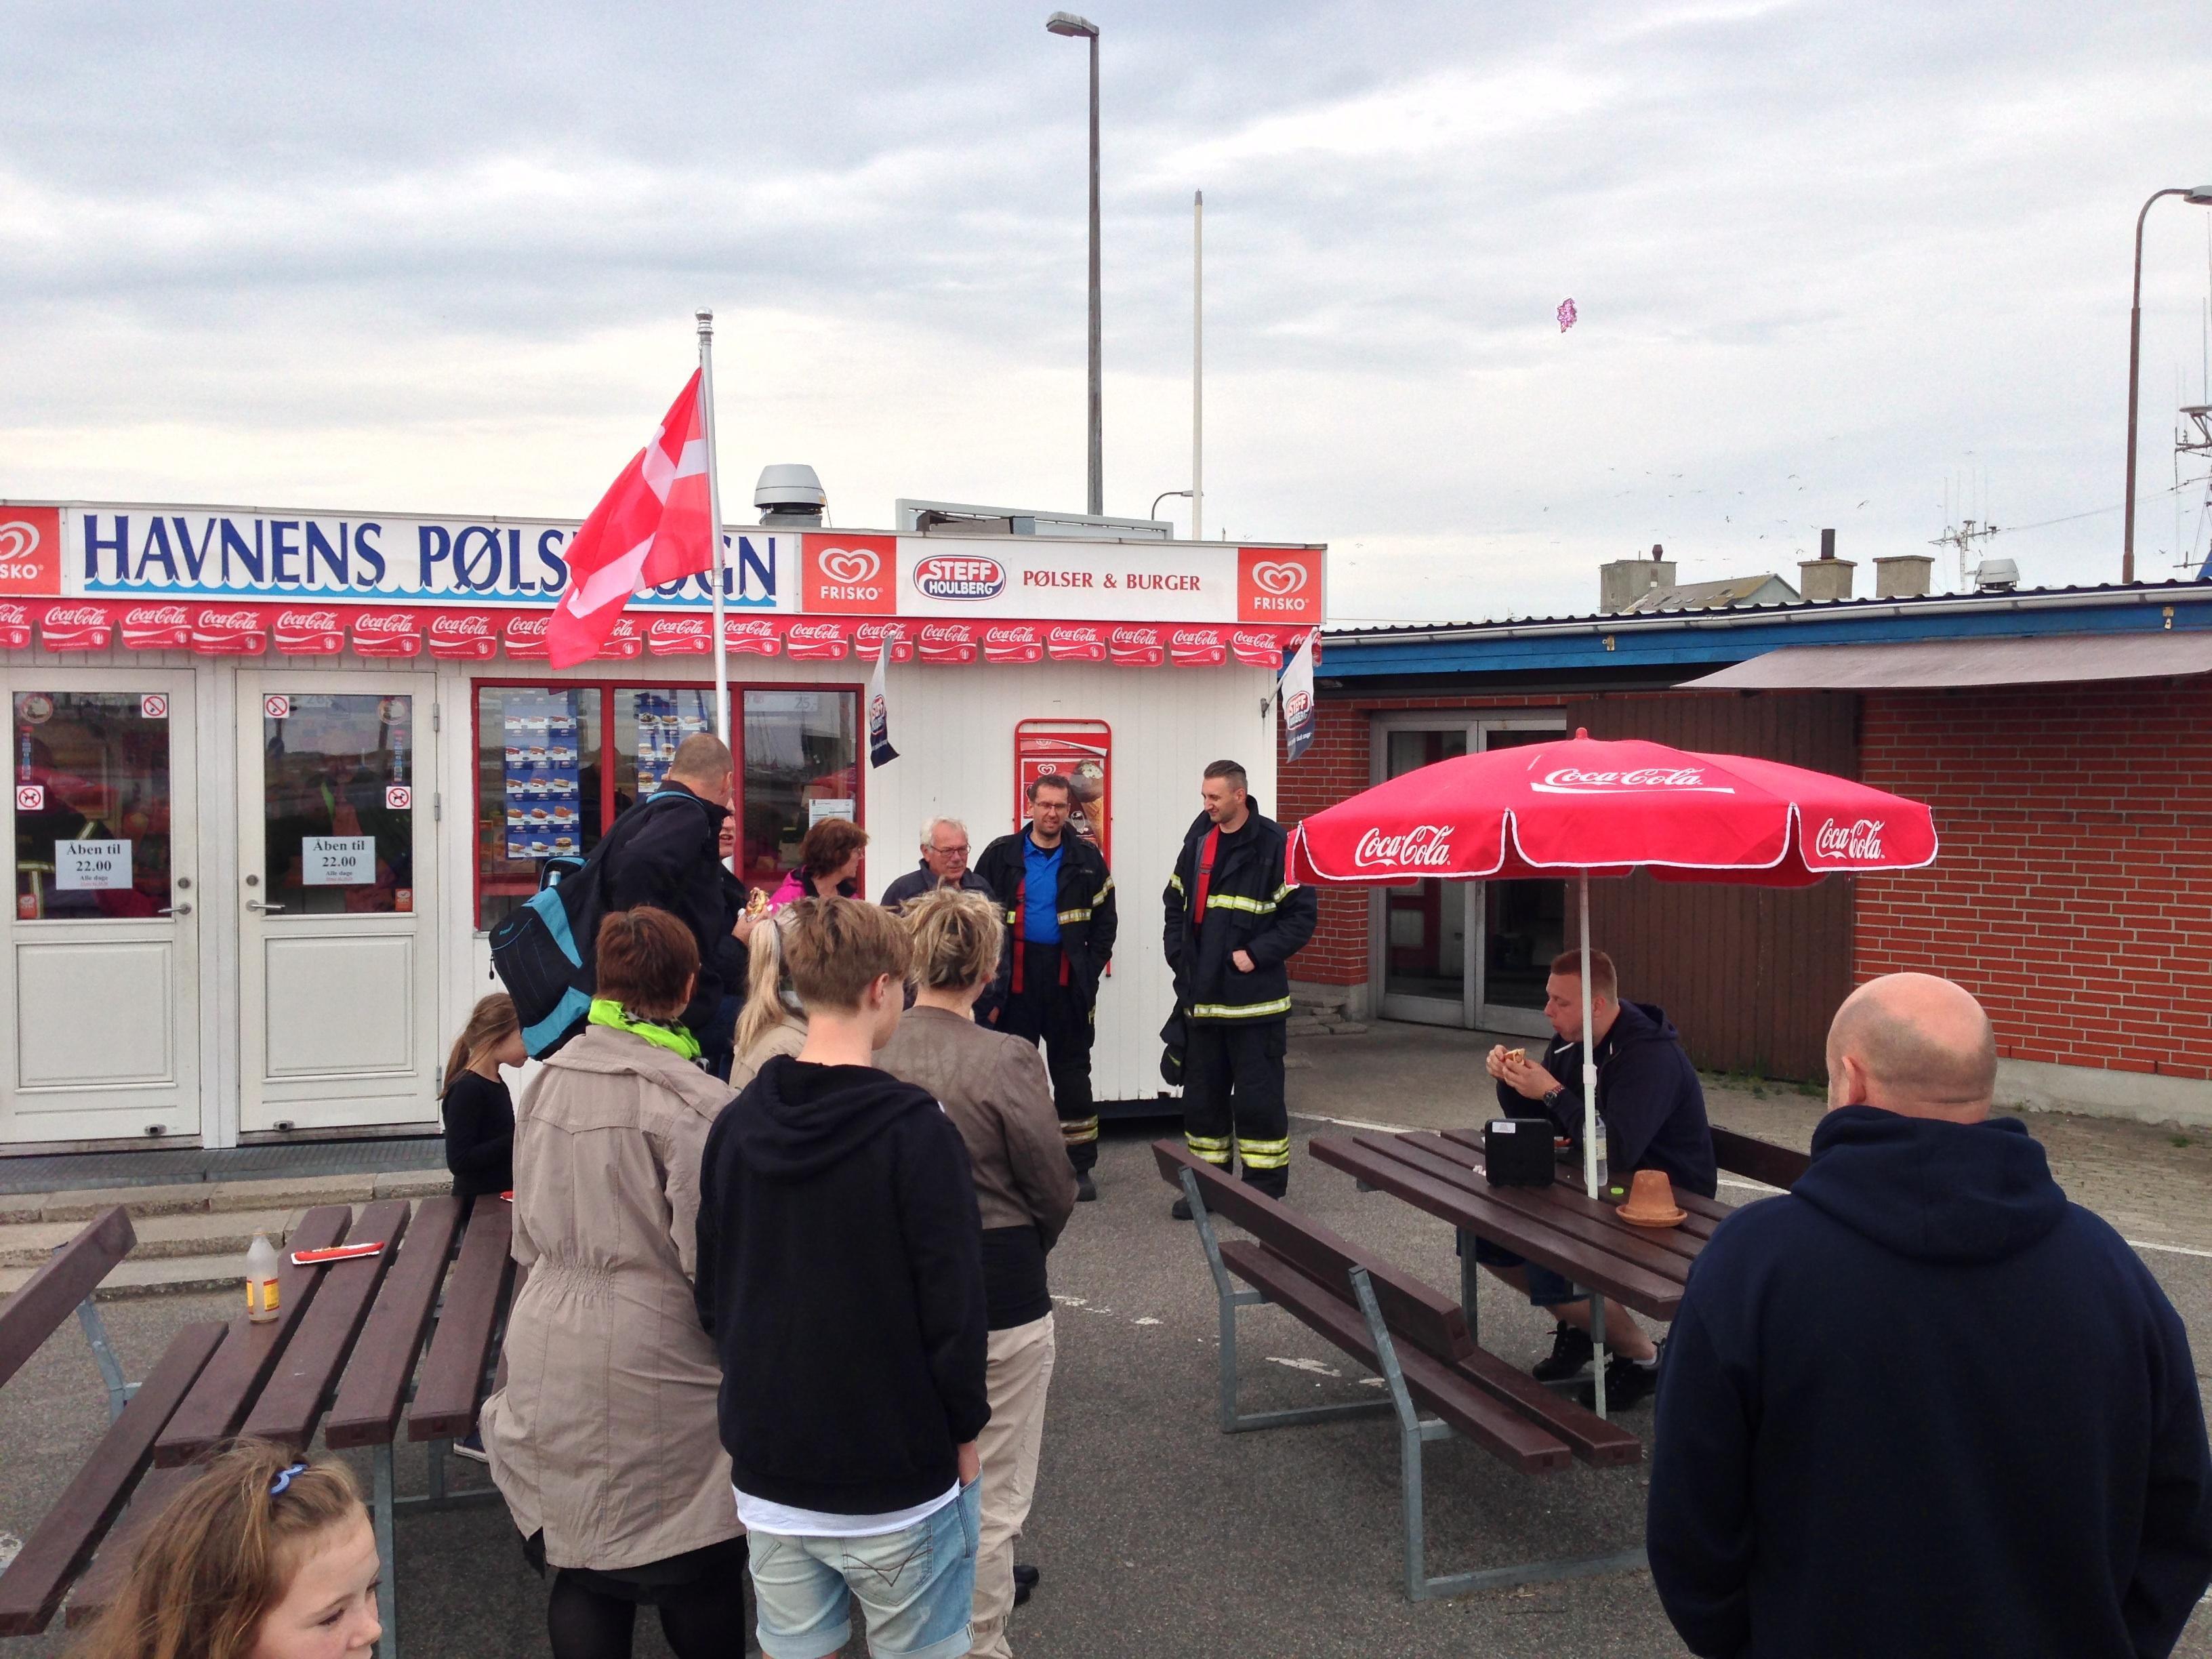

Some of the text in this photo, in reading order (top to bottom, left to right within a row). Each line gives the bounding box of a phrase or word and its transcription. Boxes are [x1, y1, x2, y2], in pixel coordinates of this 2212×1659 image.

[83, 514, 776, 597] HAVNENS PØLSN
[928, 560, 992, 581] STEFF
[929, 581, 993, 595] HOULBERG
[1023, 570, 1201, 590] PØLSER & BURGER
[821, 586, 878, 600] FRISKO
[1254, 597, 1305, 611] FRISKO
[45, 607, 108, 626] Coca-Cola
[125, 606, 188, 624] Coca-Cola
[199, 610, 260, 630] Coca-Cola
[277, 611, 338, 630] Coca-Cola
[355, 613, 415, 632] Coca-Cola
[432, 615, 490, 634] Coca-Cola
[651, 619, 706, 635] Coca-Cola
[724, 619, 774, 636] Coca-Cola
[790, 623, 842, 639] Coca-Cola
[921, 623, 978, 642] Coca-Cola
[987, 627, 1036, 642] Coca-Cola
[1050, 626, 1101, 642] Coca-Cola
[1111, 627, 1164, 645] Coca-Cola
[1172, 629, 1218, 645] Coca-Cola
[1233, 630, 1278, 649] Coca-Cola
[1544, 768, 1706, 785] Coca-Cola
[313, 838, 365, 851] Åben til
[1355, 825, 1455, 867] Coca-Cola
[1816, 818, 1885, 859] Coca-Cola
[66, 842, 121, 855] Åben til
[76, 860, 112, 872] 22.00
[322, 856, 356, 867] 22.00
